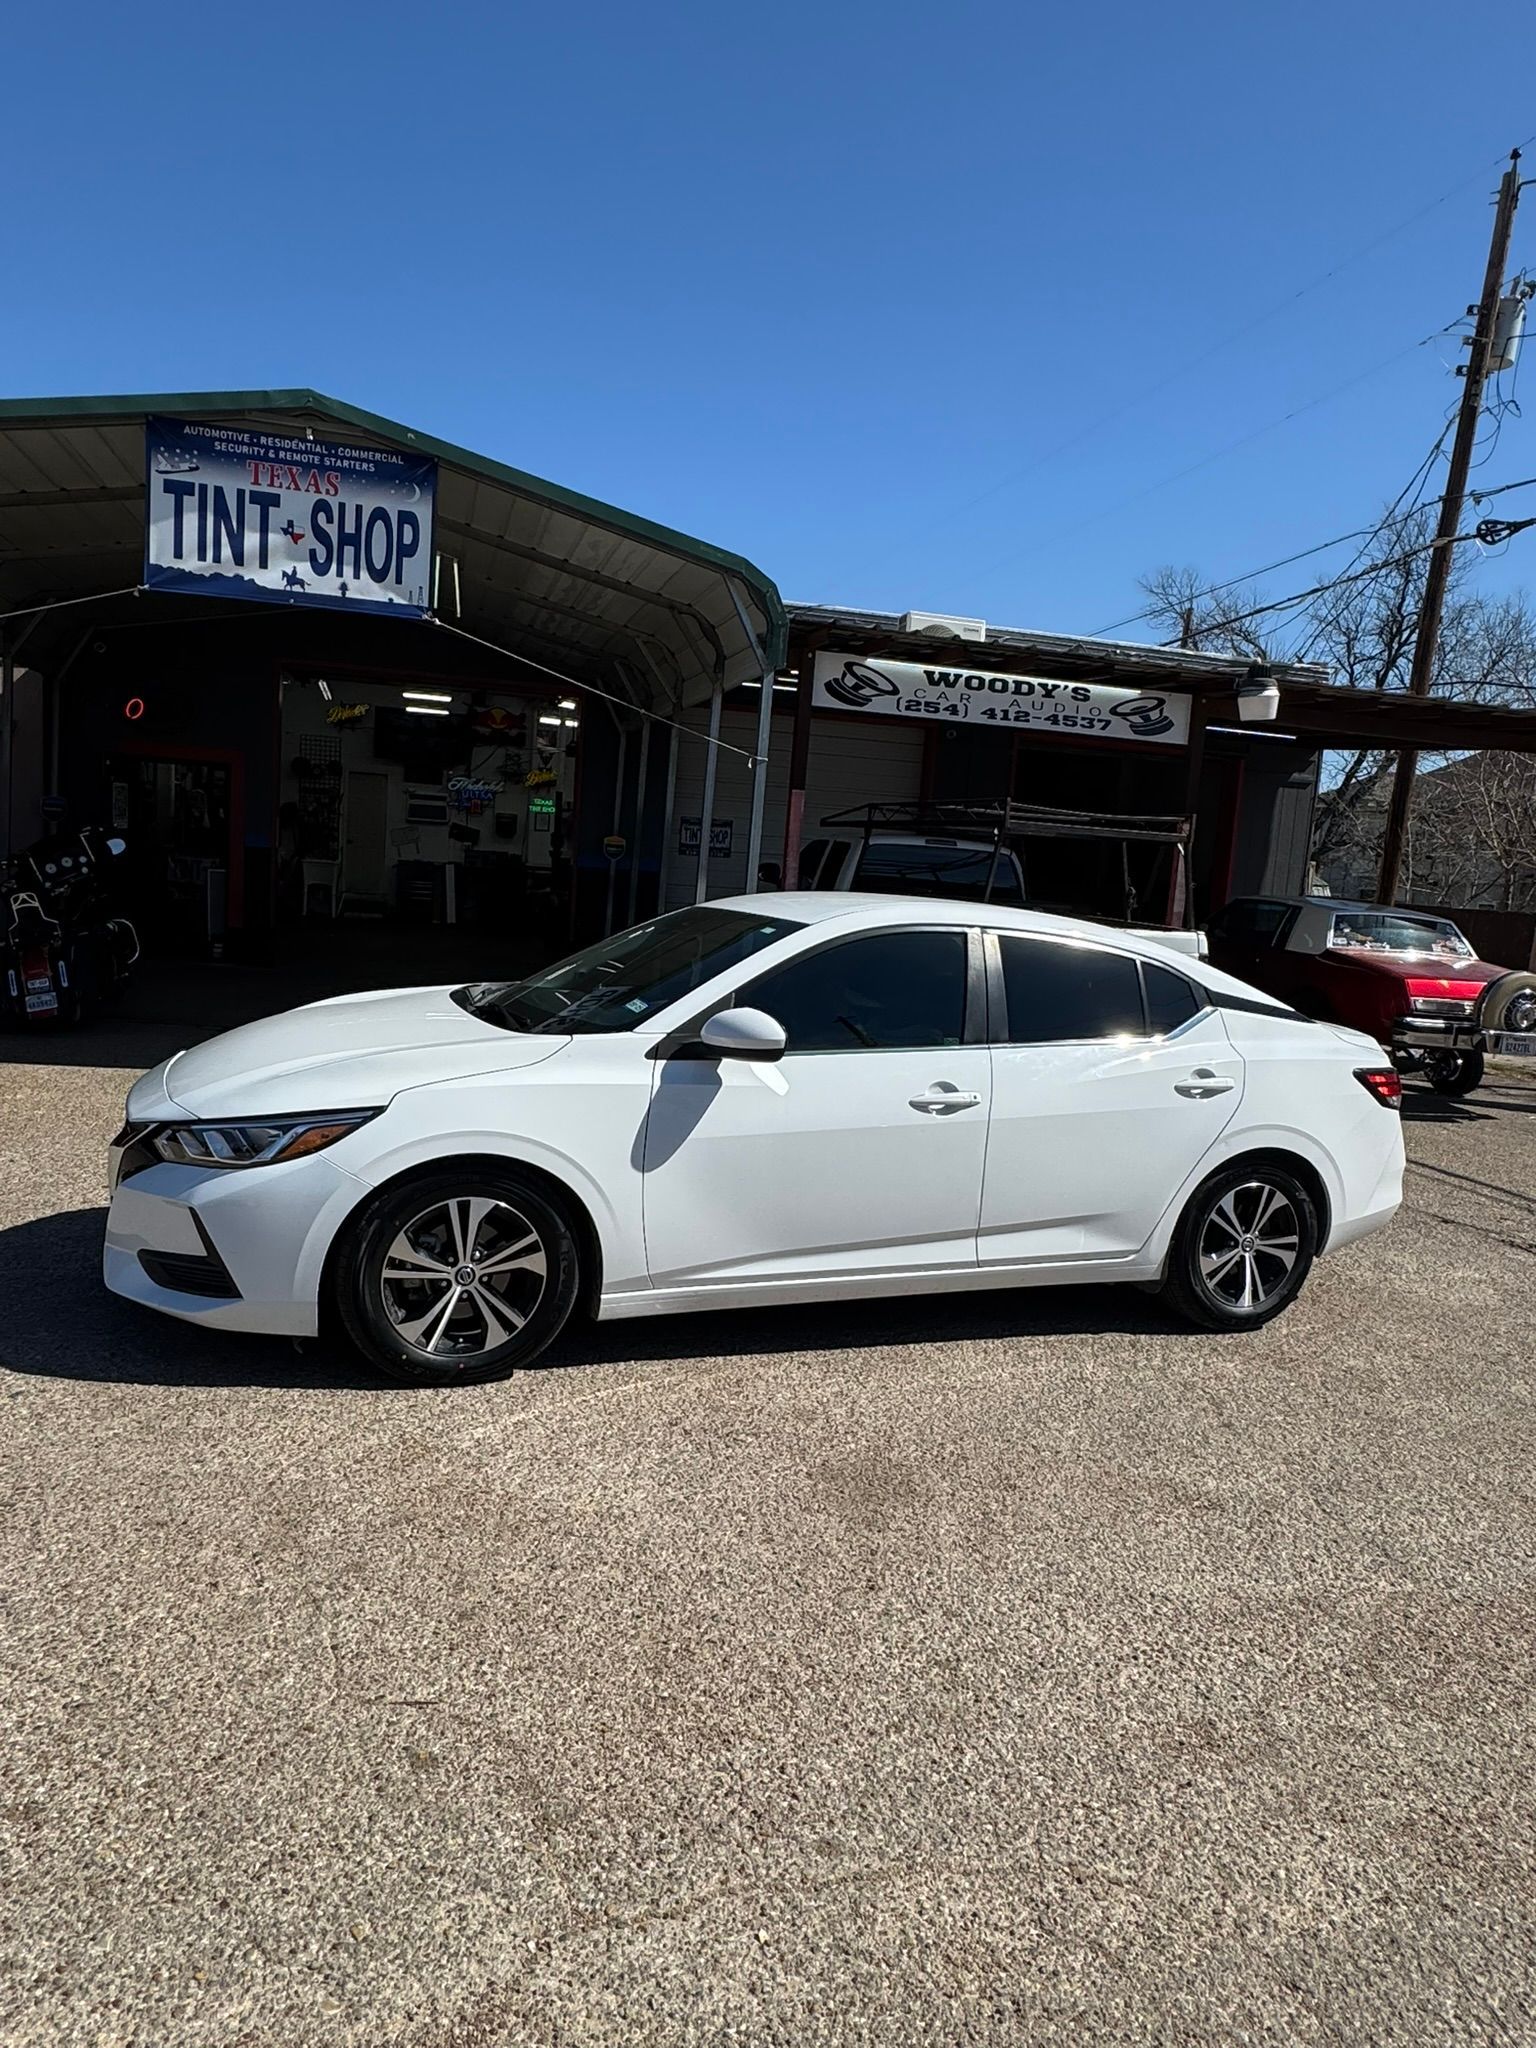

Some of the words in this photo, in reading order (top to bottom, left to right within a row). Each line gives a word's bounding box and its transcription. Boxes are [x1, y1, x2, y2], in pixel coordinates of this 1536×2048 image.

[184, 425, 251, 443] AUTOMOTIVE
[260, 436, 328, 455] RESIDENTIAL
[338, 447, 404, 465] COMMERCIAL
[214, 441, 266, 457] SECURITY
[268, 449, 275, 458] &
[279, 450, 320, 465] REMOTE
[324, 457, 375, 472] STARTERS
[246, 460, 341, 497] TEXAS
[163, 478, 281, 570] TINT
[309, 498, 420, 585] SHOP
[914, 688, 971, 704] CAR
[1009, 699, 1101, 718] AUDIO
[924, 670, 1091, 702] WOODY'S
[896, 696, 969, 719] (254)
[980, 707, 1112, 732] 412-4537
